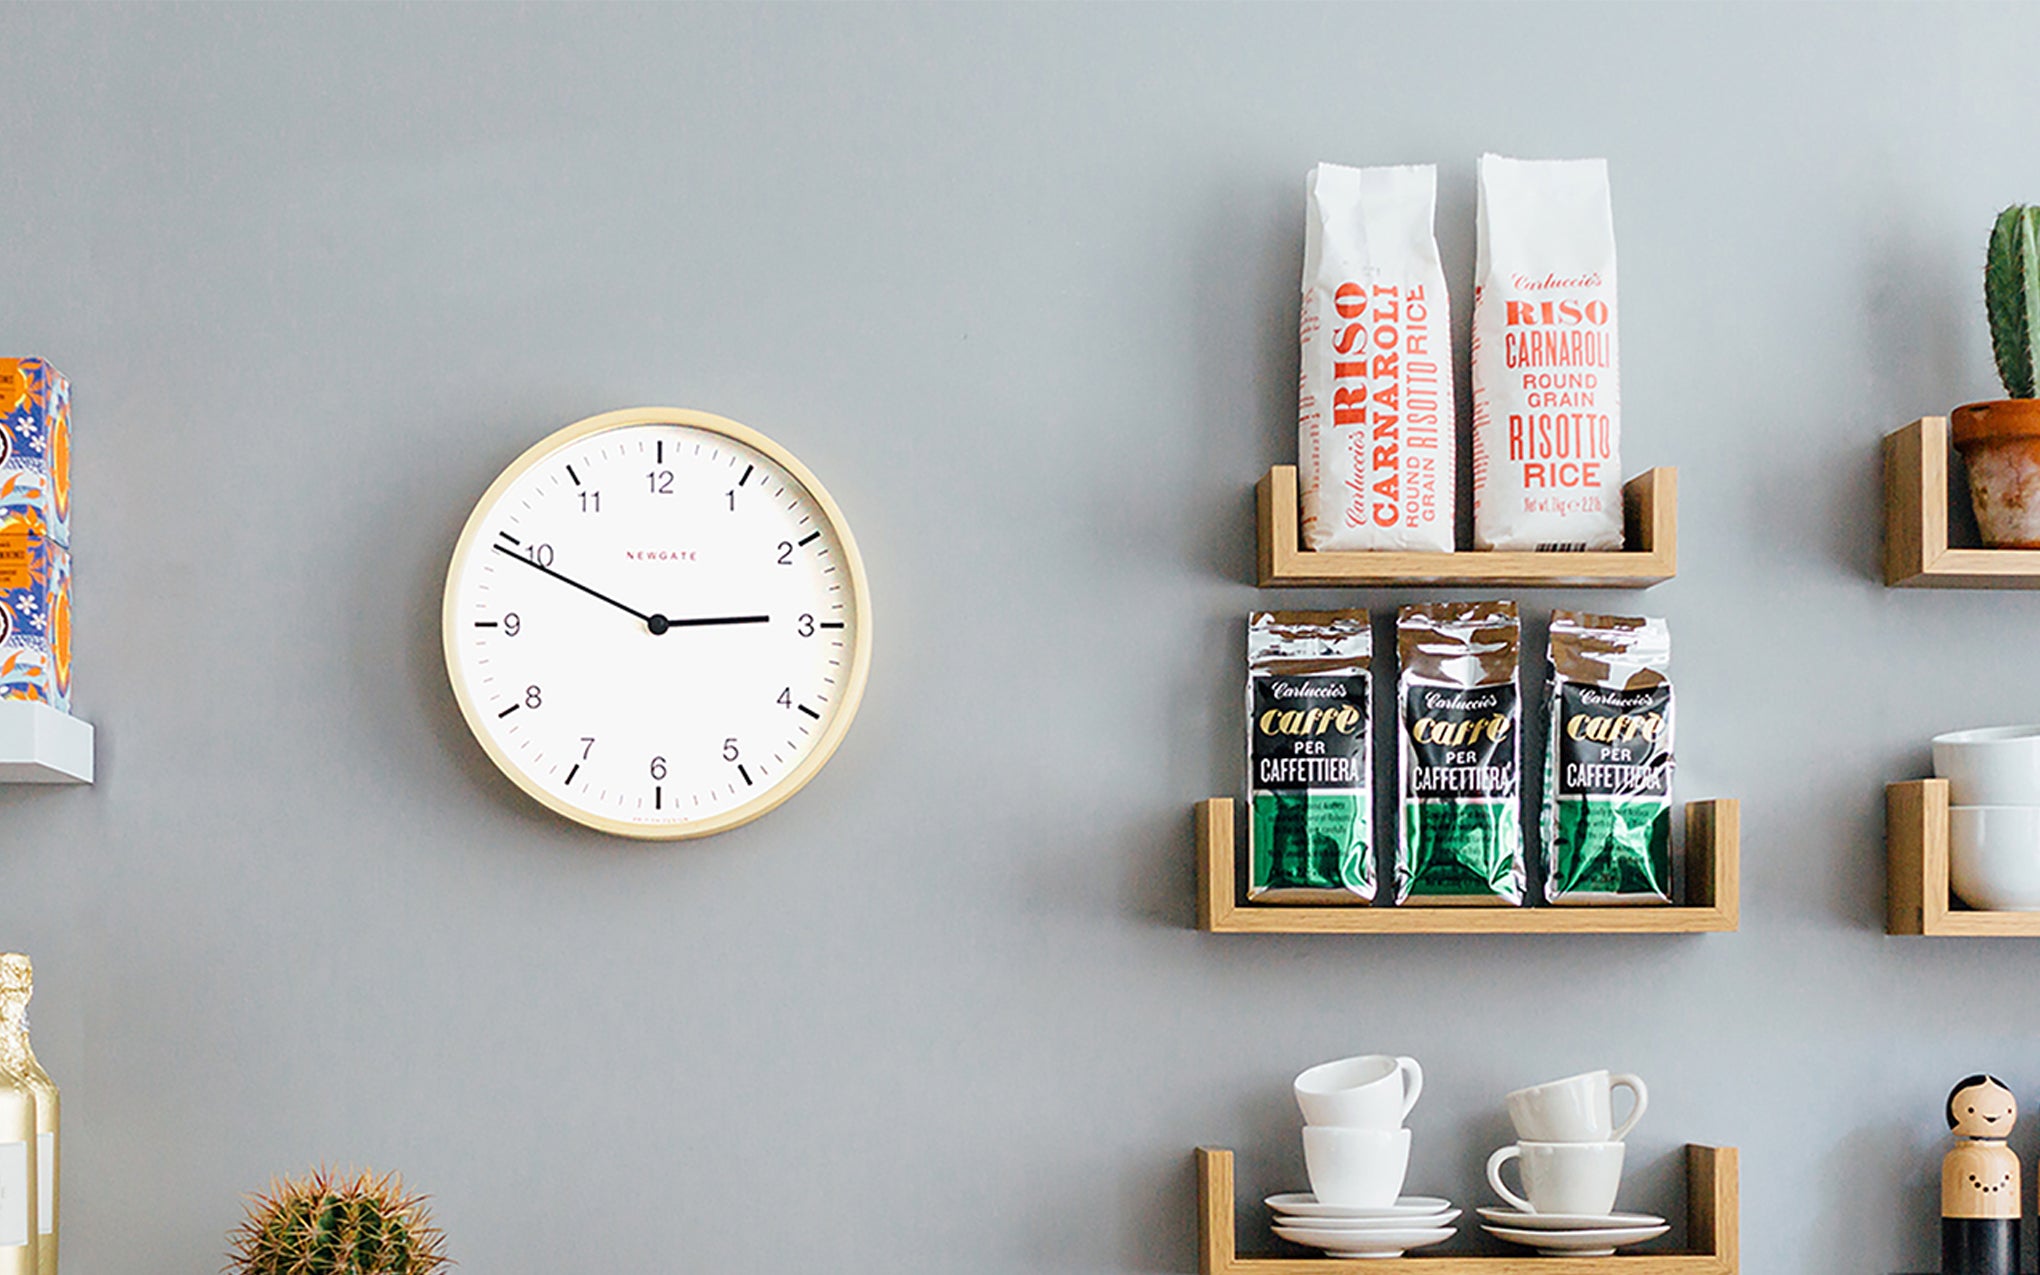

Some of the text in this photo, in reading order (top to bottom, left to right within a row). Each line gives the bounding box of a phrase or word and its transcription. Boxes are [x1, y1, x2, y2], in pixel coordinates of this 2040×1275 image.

[1511, 272, 1602, 291] Carluccio's
[1504, 300, 1609, 327] RISO
[1505, 330, 1610, 369] CARNAROLI
[1406, 284, 1438, 449] RISOTTO RICE
[1523, 373, 1598, 390] ROUND
[1333, 281, 1368, 528] Carluccio's RISO
[1372, 284, 1400, 528] CARNAROLI
[1527, 391, 1594, 408] GRAIN
[1509, 413, 1611, 461] RISOTTO
[646, 471, 674, 494] 12
[1524, 463, 1602, 488] RICE
[578, 491, 600, 512] 11
[725, 489, 735, 511] 1
[1406, 456, 1420, 528] ROUND
[1422, 458, 1435, 522] GRAIN
[525, 544, 554, 568] 10
[626, 551, 697, 561] NEWGATE
[777, 541, 793, 565] 2
[504, 613, 521, 636] 9
[797, 613, 815, 637] 3
[525, 685, 542, 709] 8
[776, 686, 792, 709] 4
[1271, 681, 1348, 699] Carluccio's
[1425, 690, 1498, 711] Carluccio's
[1579, 687, 1653, 707] Carluccio's
[1259, 703, 1360, 736] caffè
[580, 737, 595, 759] 7
[722, 738, 739, 762] 5
[1294, 742, 1326, 755] PER
[1445, 751, 1477, 764] PER
[1600, 749, 1632, 762] PER
[650, 756, 667, 780] 6
[1260, 758, 1359, 783] CAFFETTIERA
[1413, 766, 1506, 791] CAFFETTIERA
